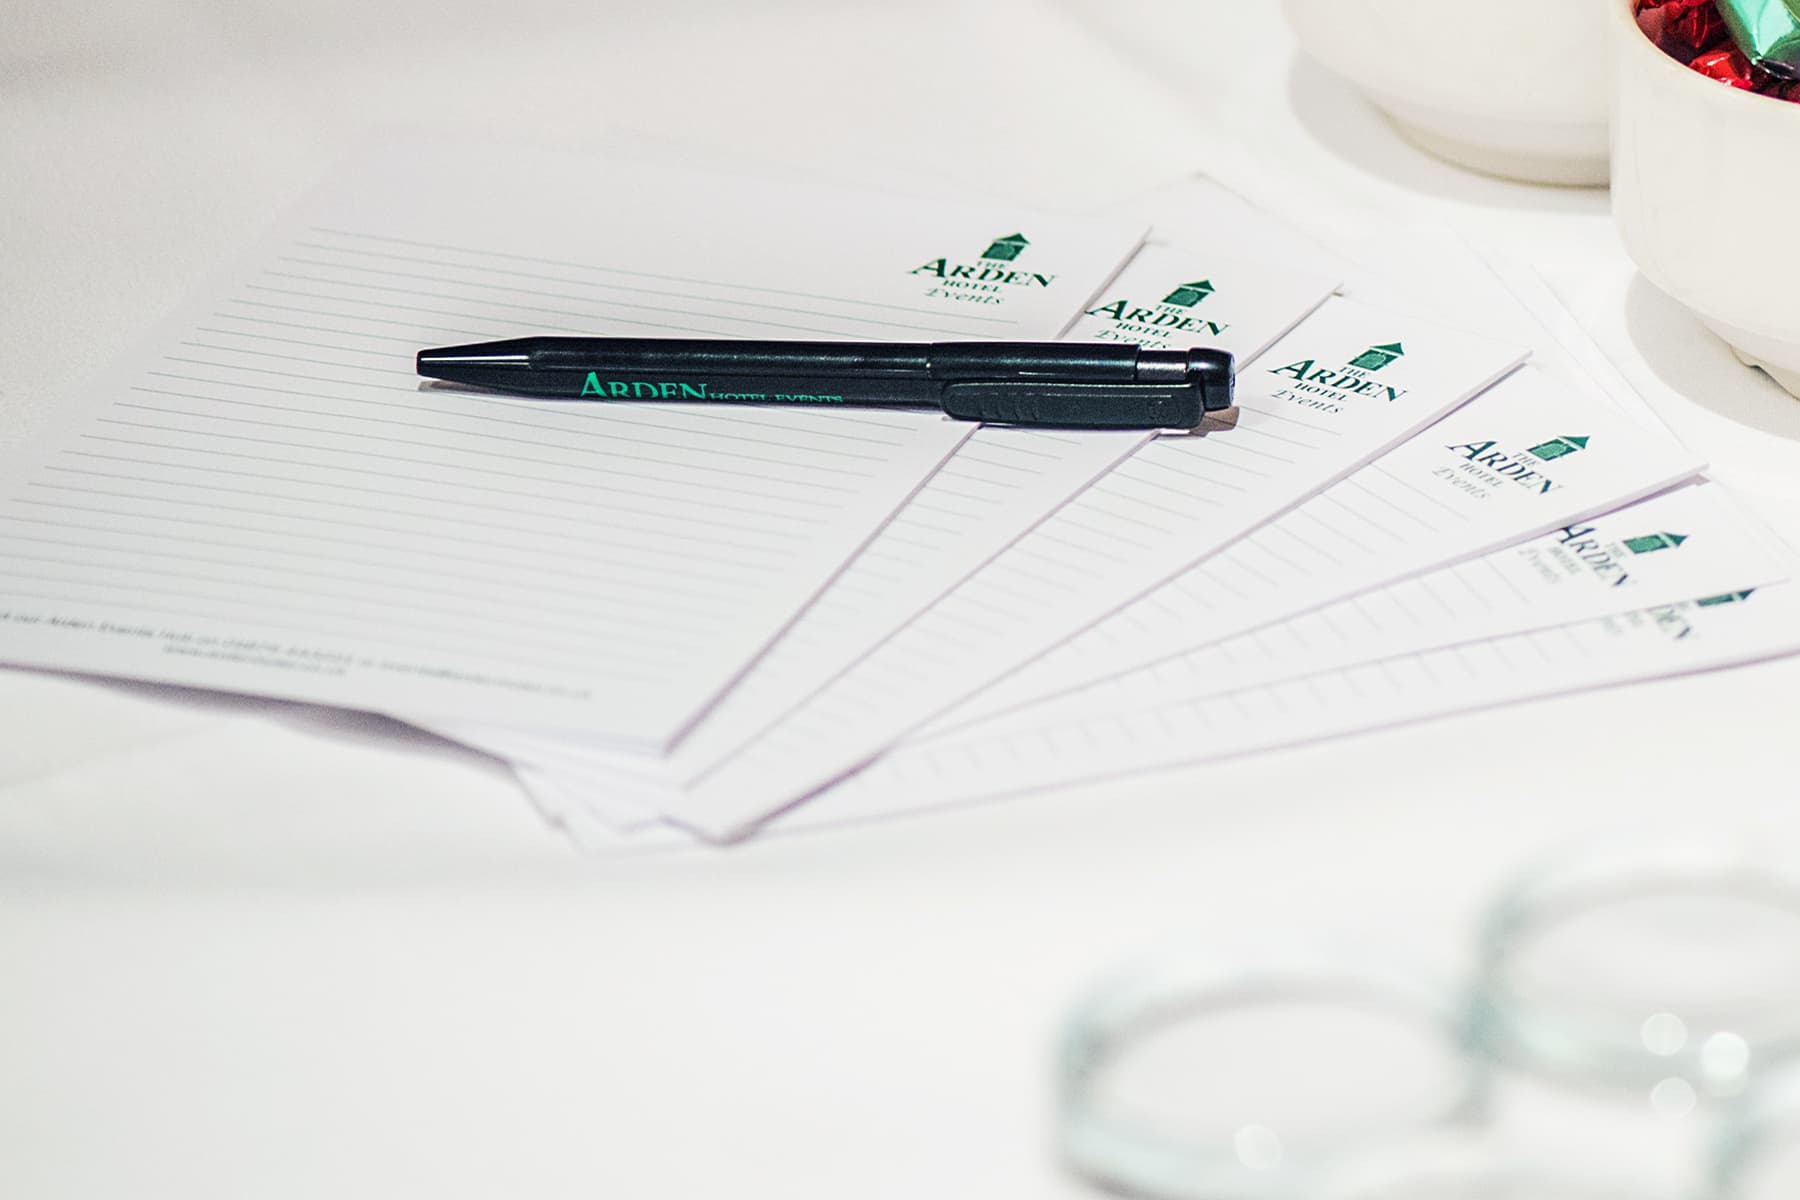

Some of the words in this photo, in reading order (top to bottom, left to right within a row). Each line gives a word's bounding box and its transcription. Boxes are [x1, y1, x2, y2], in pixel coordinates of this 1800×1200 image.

[907, 258, 1058, 287] ARDEN
[943, 280, 1000, 292] HOTEL
[1084, 300, 1230, 336] ARDEN
[1155, 305, 1184, 314] THE
[1115, 322, 1172, 338] HOTEL
[580, 371, 707, 399] ARDEN
[1268, 359, 1407, 401] ARDEN
[1339, 367, 1369, 378] THE
[1272, 389, 1343, 414] Events
[1294, 383, 1348, 401] HOTEL
[1445, 441, 1563, 494] ARDEN
